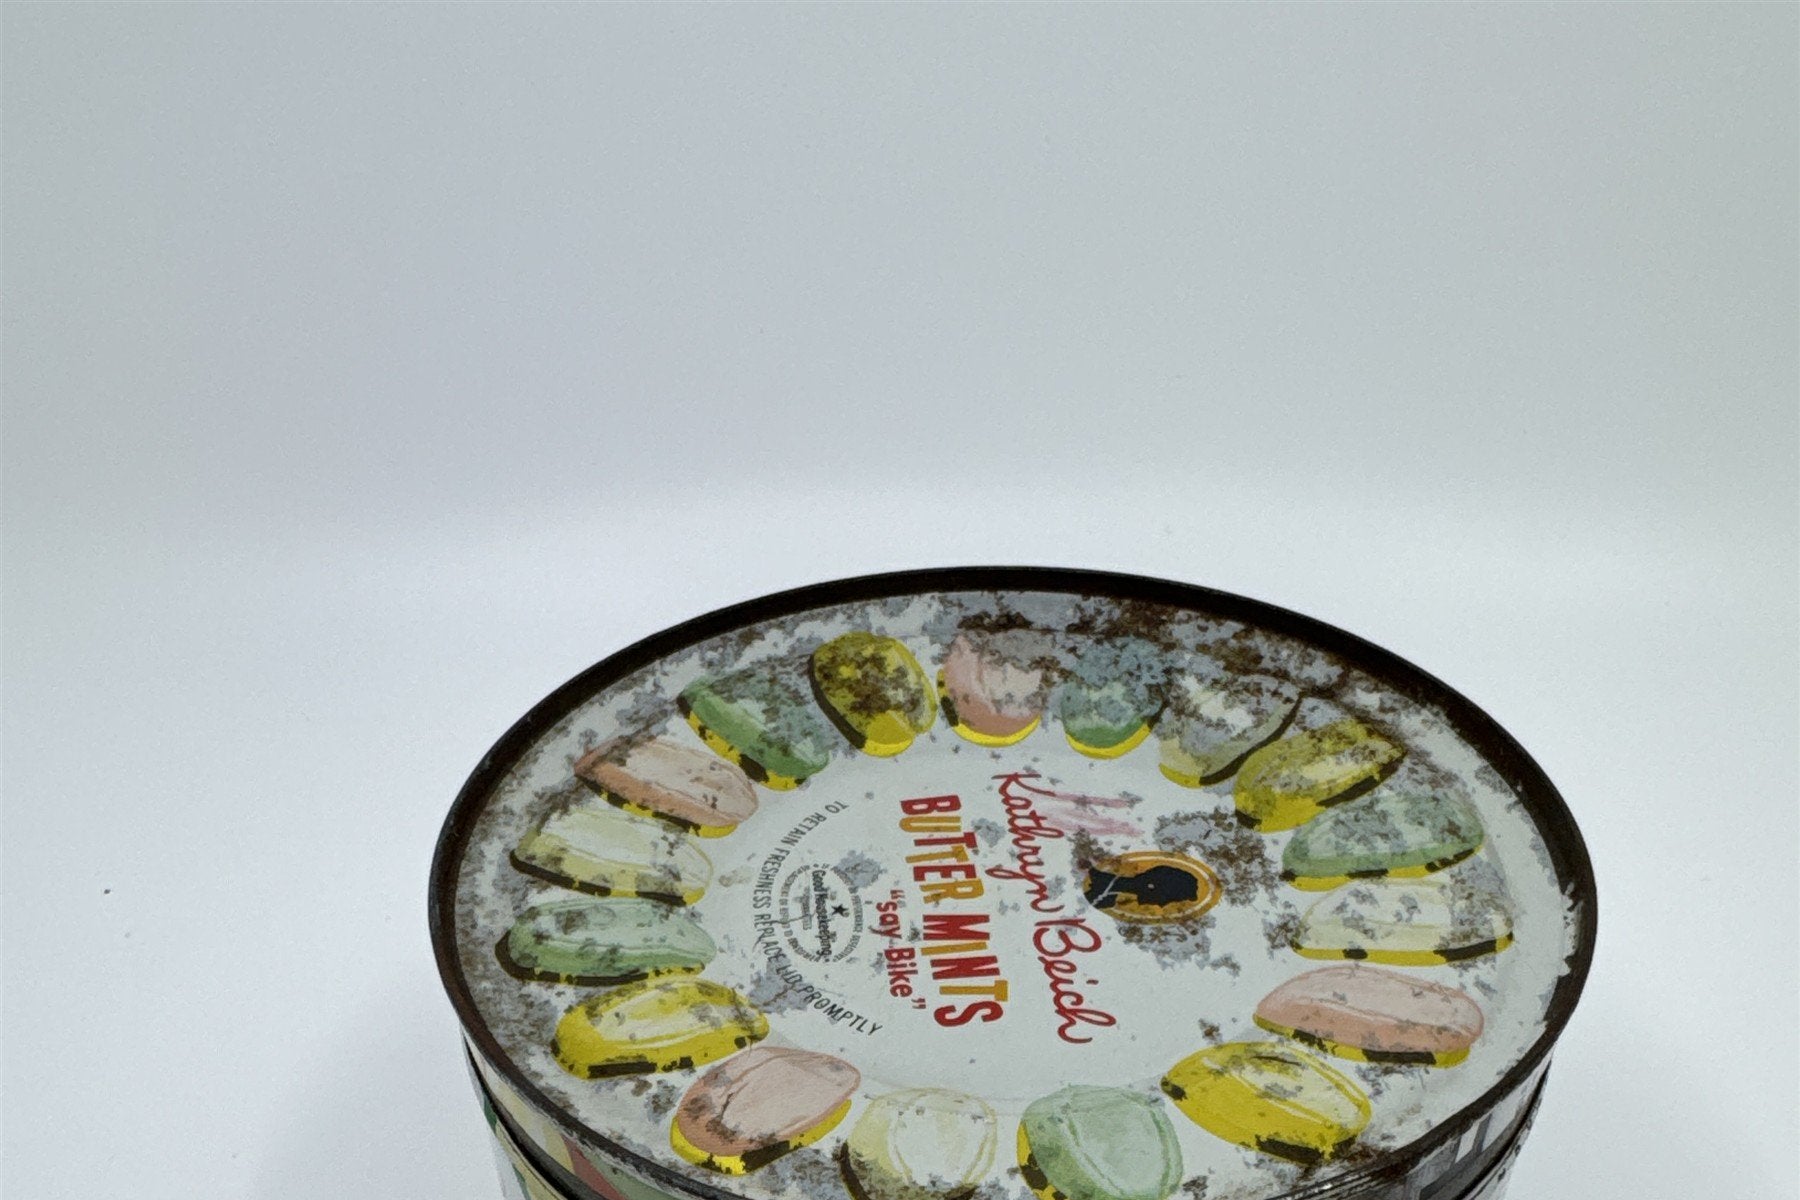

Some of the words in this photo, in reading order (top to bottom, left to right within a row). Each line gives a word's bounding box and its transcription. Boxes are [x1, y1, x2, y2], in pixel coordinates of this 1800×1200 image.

[780, 811, 827, 847] RETAIN
[824, 800, 850, 815] TO
[899, 794, 985, 904] BUTTER
[752, 847, 791, 910] FRESHNESS
[812, 869, 828, 893] Good
[814, 893, 832, 957] Housekeeping
[985, 772, 1065, 913] Kathryn
[1033, 917, 1118, 1044] Beich
[753, 913, 787, 962] REPLACE
[775, 963, 803, 985] LID
[920, 913, 1008, 1028] MINTS
[796, 984, 883, 1036] PROMPTLY
